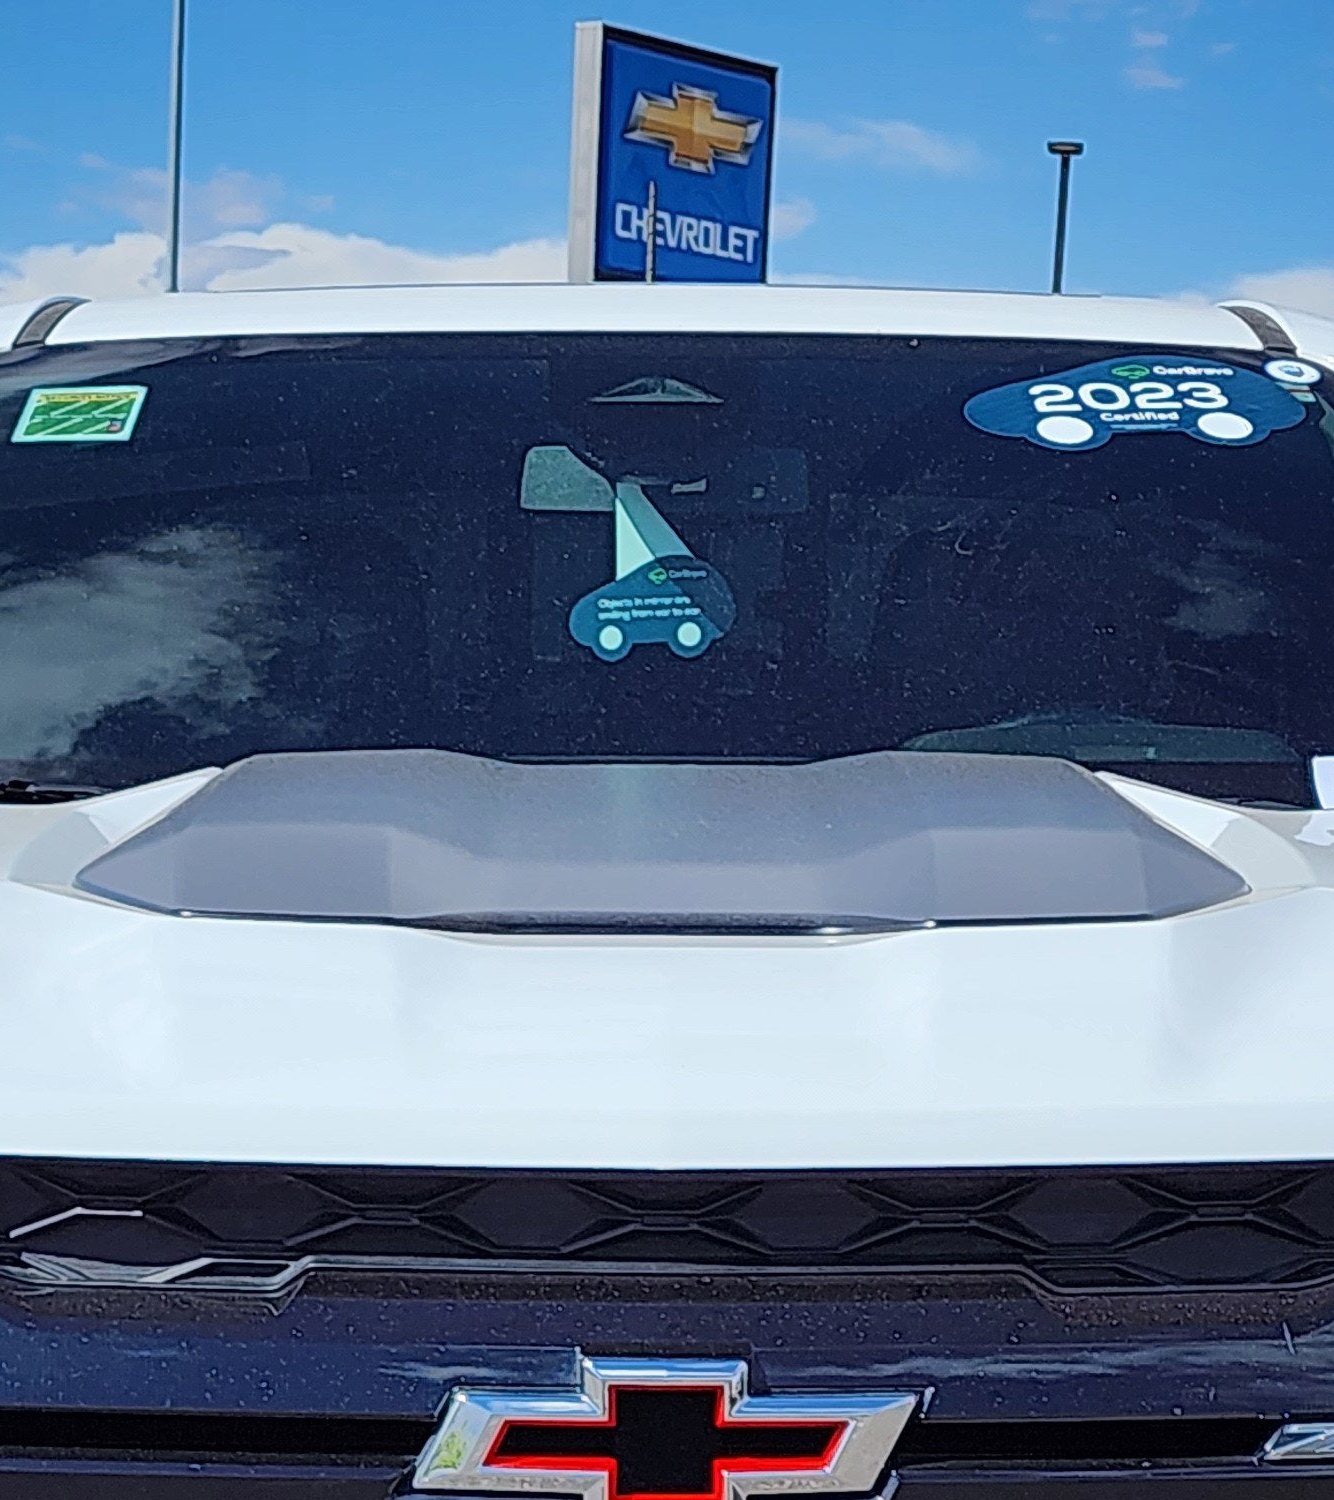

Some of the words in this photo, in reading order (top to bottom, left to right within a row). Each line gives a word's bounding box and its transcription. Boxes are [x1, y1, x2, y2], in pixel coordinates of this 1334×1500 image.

[616, 202, 759, 263] CHEVROLET
[1028, 381, 1229, 413] 2023
[1099, 411, 1180, 422] Certified
